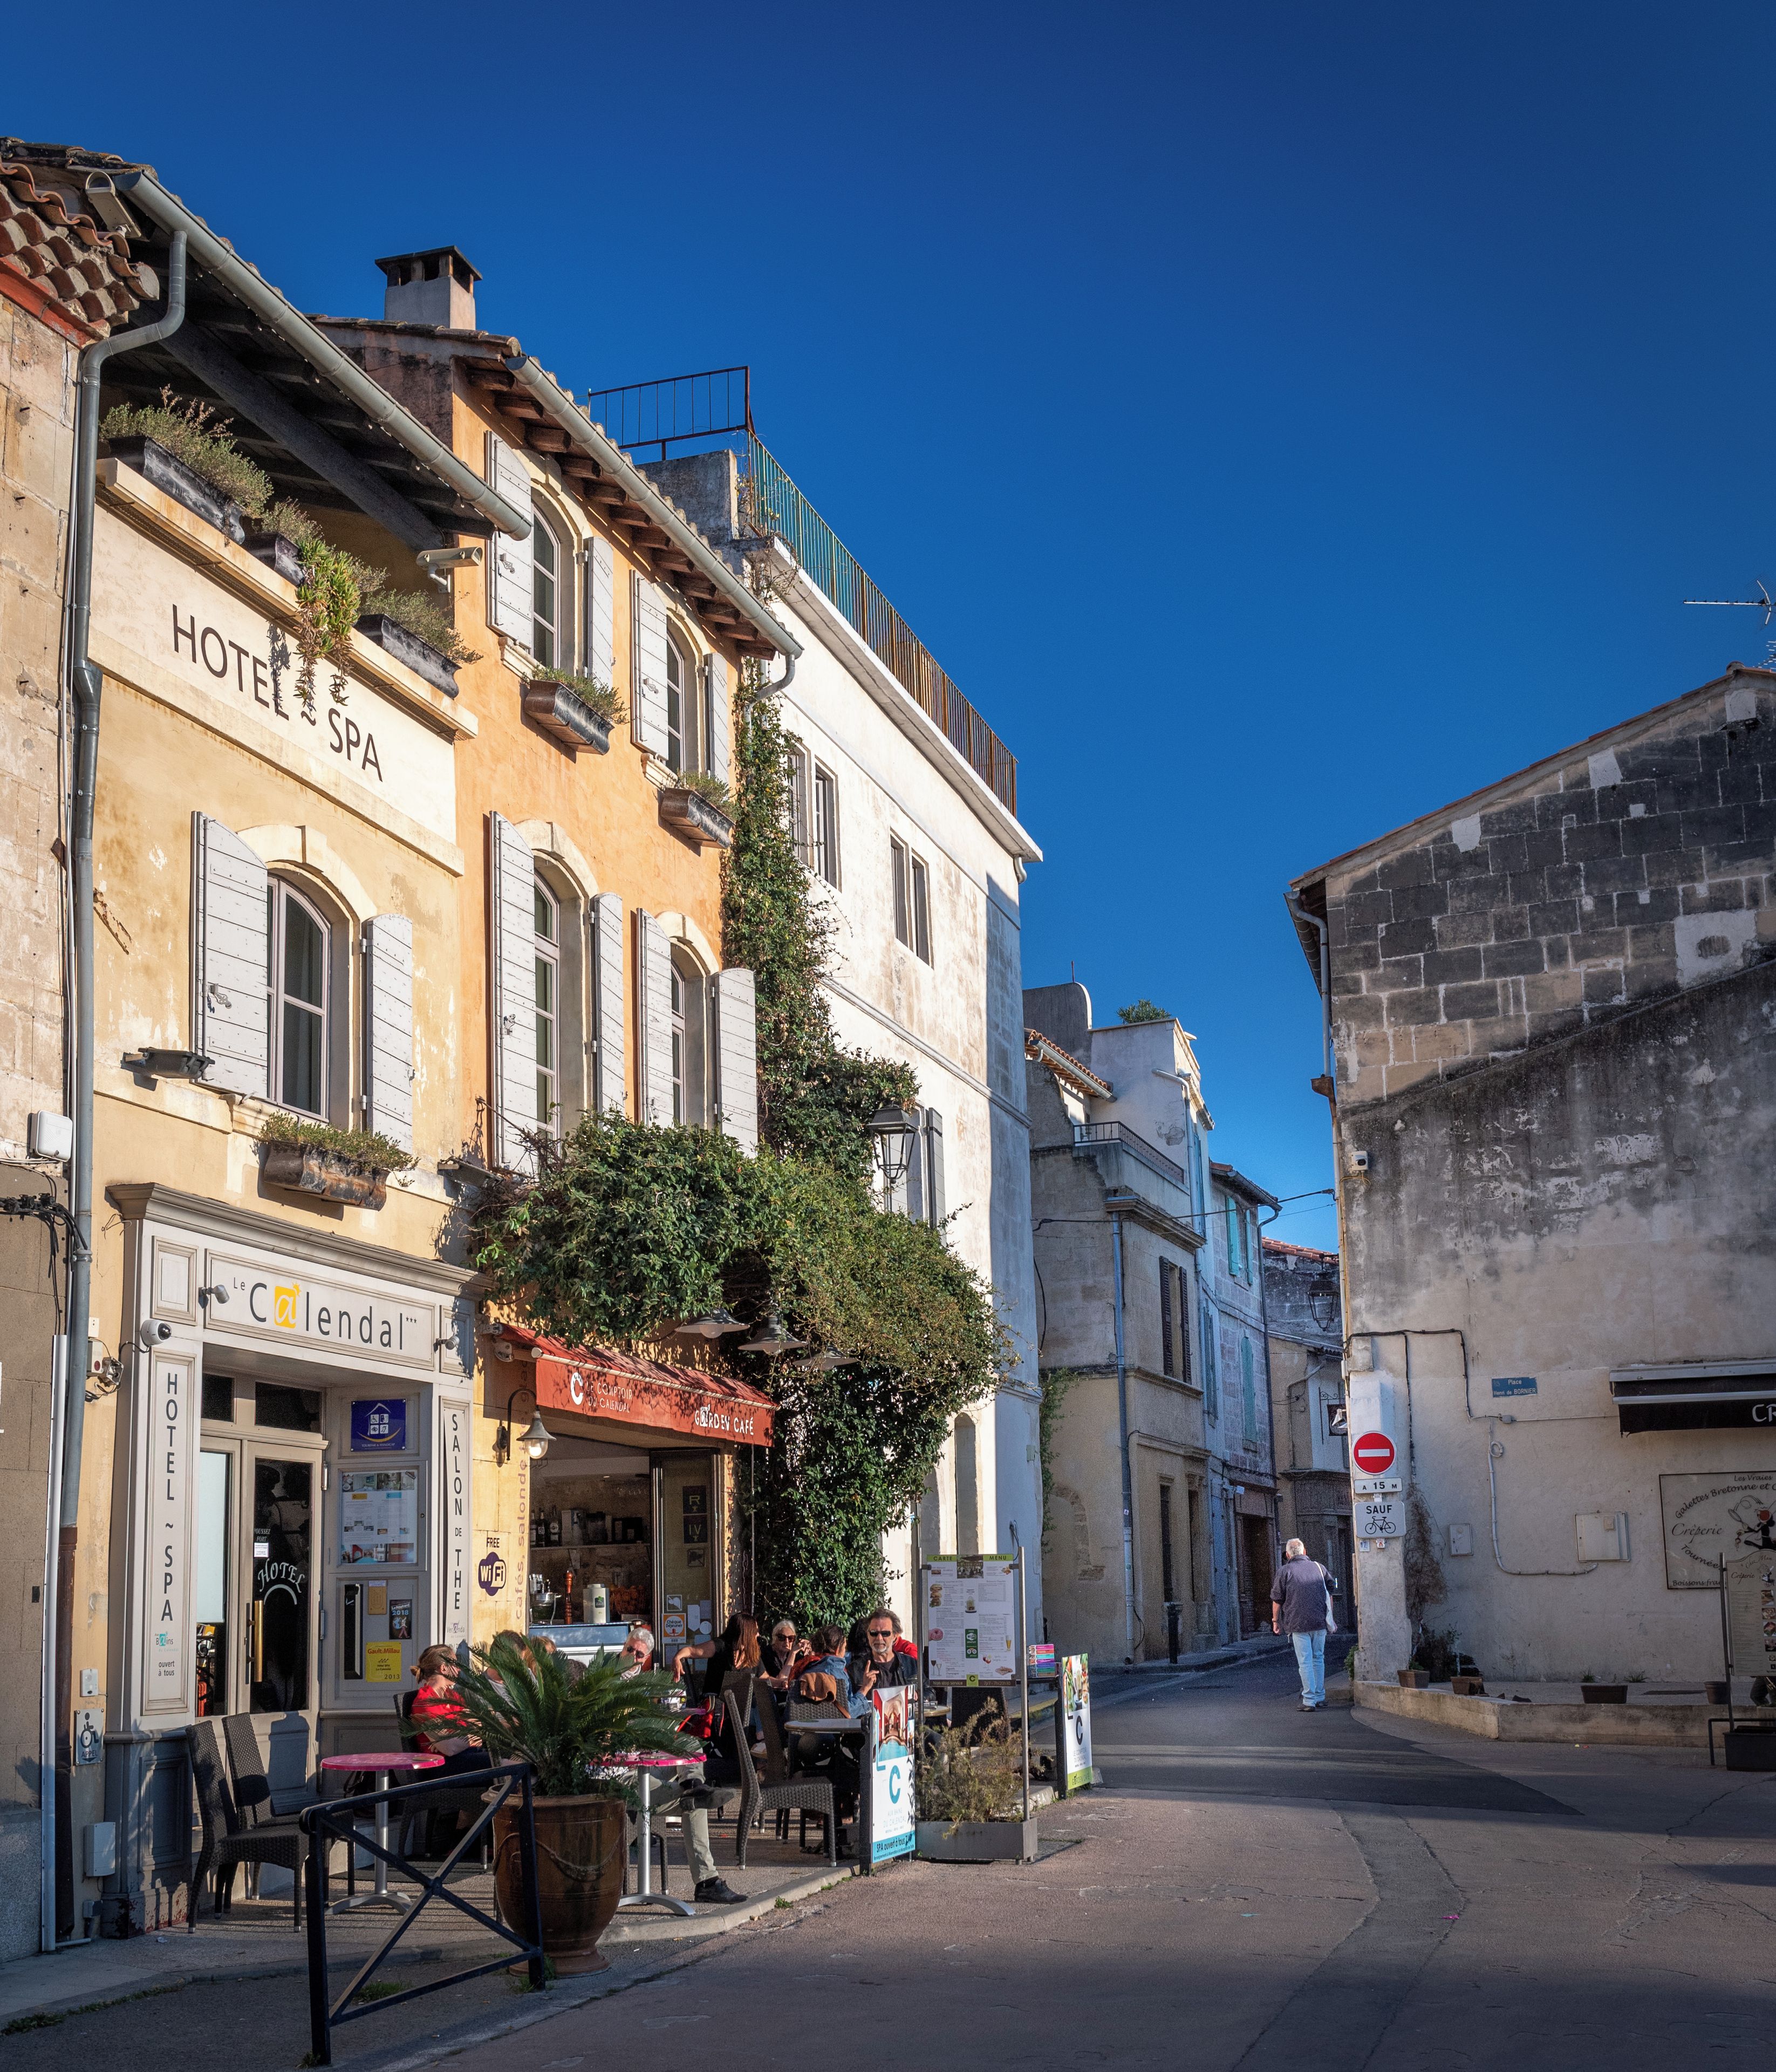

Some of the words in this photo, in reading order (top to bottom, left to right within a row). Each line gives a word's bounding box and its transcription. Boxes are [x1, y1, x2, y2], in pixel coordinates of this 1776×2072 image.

[172, 604, 290, 721] HOTEL
[327, 708, 383, 782] SPA
[233, 1277, 245, 1291] Le
[249, 1282, 403, 1350] Calendal
[597, 1382, 633, 1400] COMPTOIR
[599, 1398, 631, 1413] CALENDAL
[166, 1373, 178, 1501] HOTEL
[734, 1416, 754, 1435] CAFÉ
[452, 1413, 462, 1516] SALON
[1374, 1482, 1385, 1490] 15
[1366, 1504, 1392, 1515] SAUF
[1675, 1491, 1710, 1519] Galettes
[1710, 1483, 1758, 1498] Bretonne
[455, 1528, 462, 1537] DE
[486, 1537, 500, 1548] FREE
[1671, 1523, 1723, 1544] Crêperie
[160, 1545, 174, 1621] SPA
[257, 1558, 305, 1593] HOTEL
[454, 1549, 462, 1610] THE
[1075, 1715, 1083, 1745] C
[81, 1749, 98, 1759] APPEL
[889, 1765, 901, 1804] C
[876, 1843, 884, 1853] SPA
[884, 1840, 894, 1851] ouvert
[895, 1837, 898, 1847] à
